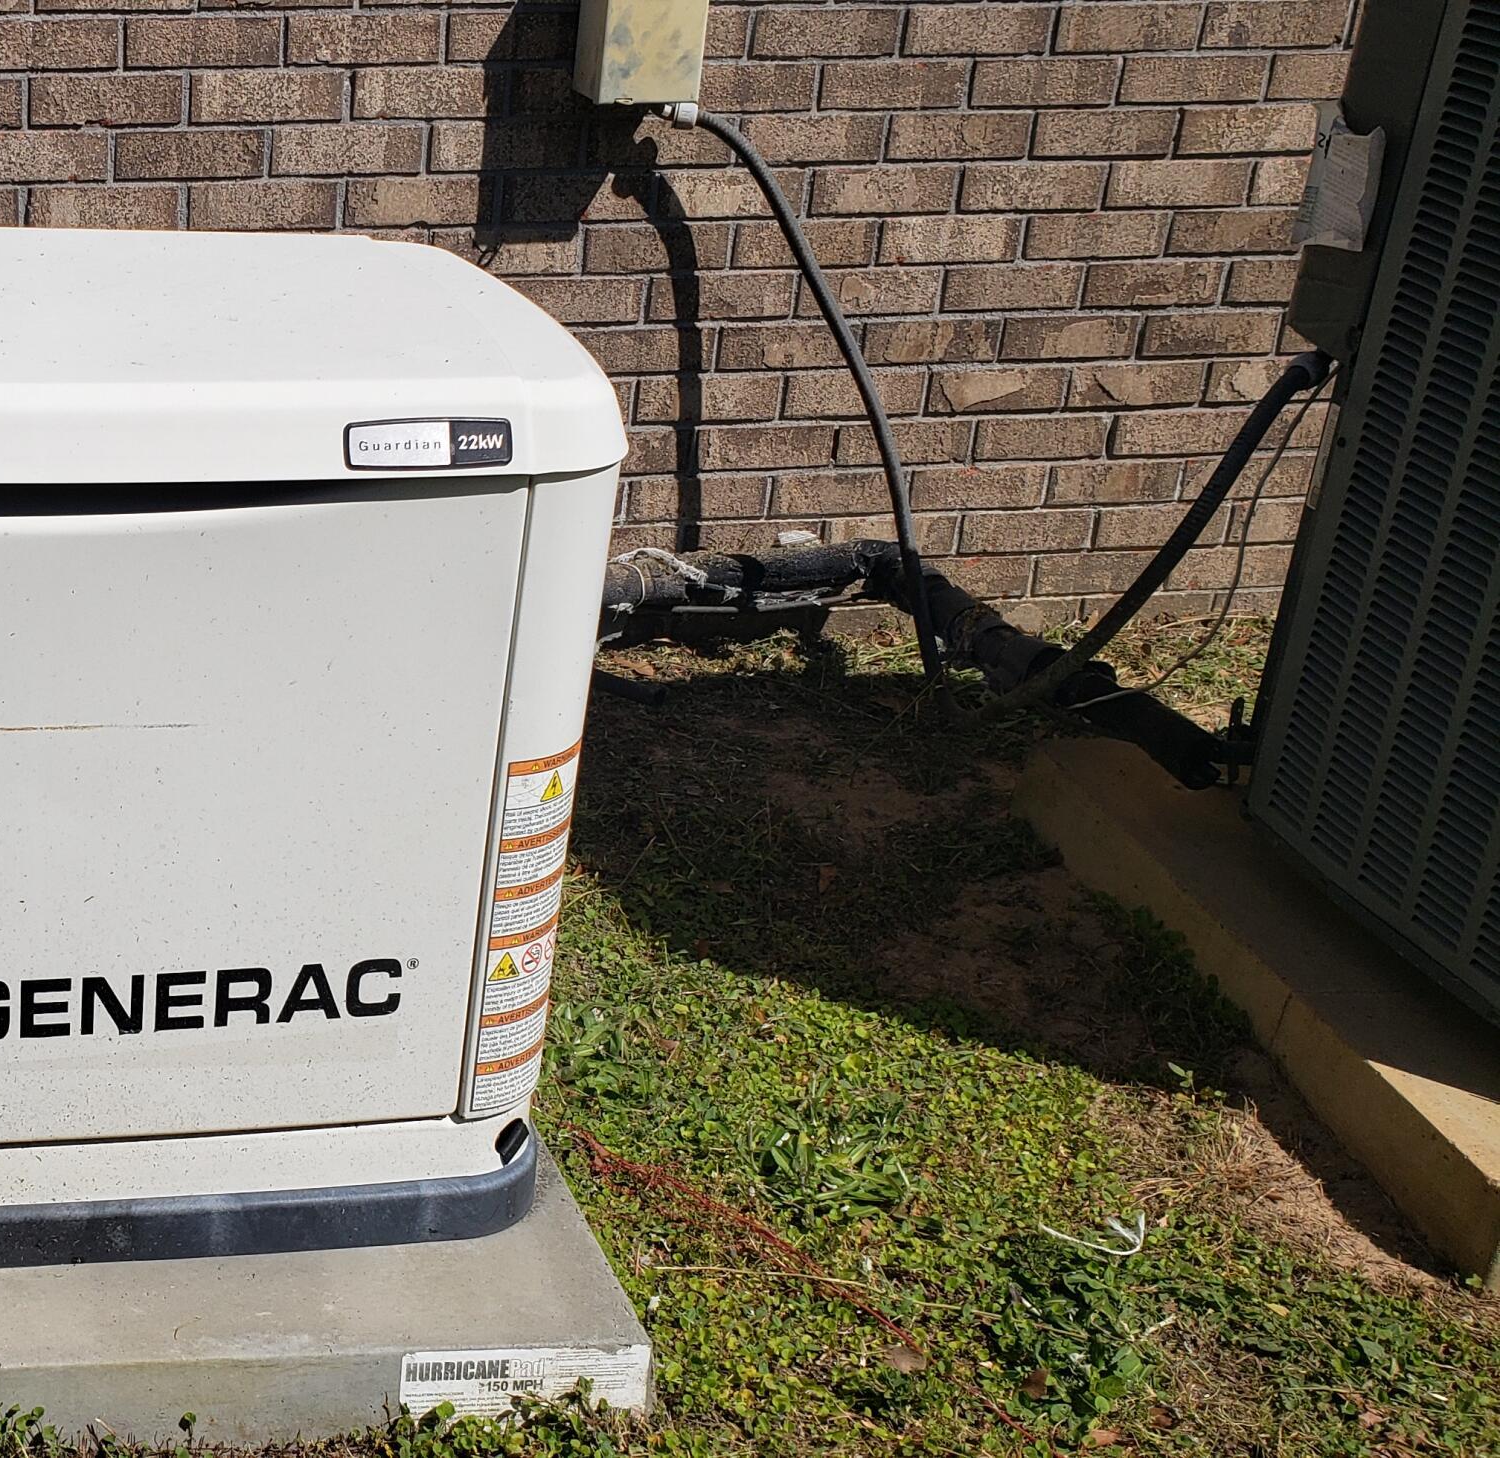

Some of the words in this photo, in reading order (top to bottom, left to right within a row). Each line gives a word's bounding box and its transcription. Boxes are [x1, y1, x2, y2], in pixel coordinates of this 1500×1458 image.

[359, 440, 441, 452] Guardian
[457, 433, 504, 450] 22kW
[512, 1379, 544, 1391] MPH
